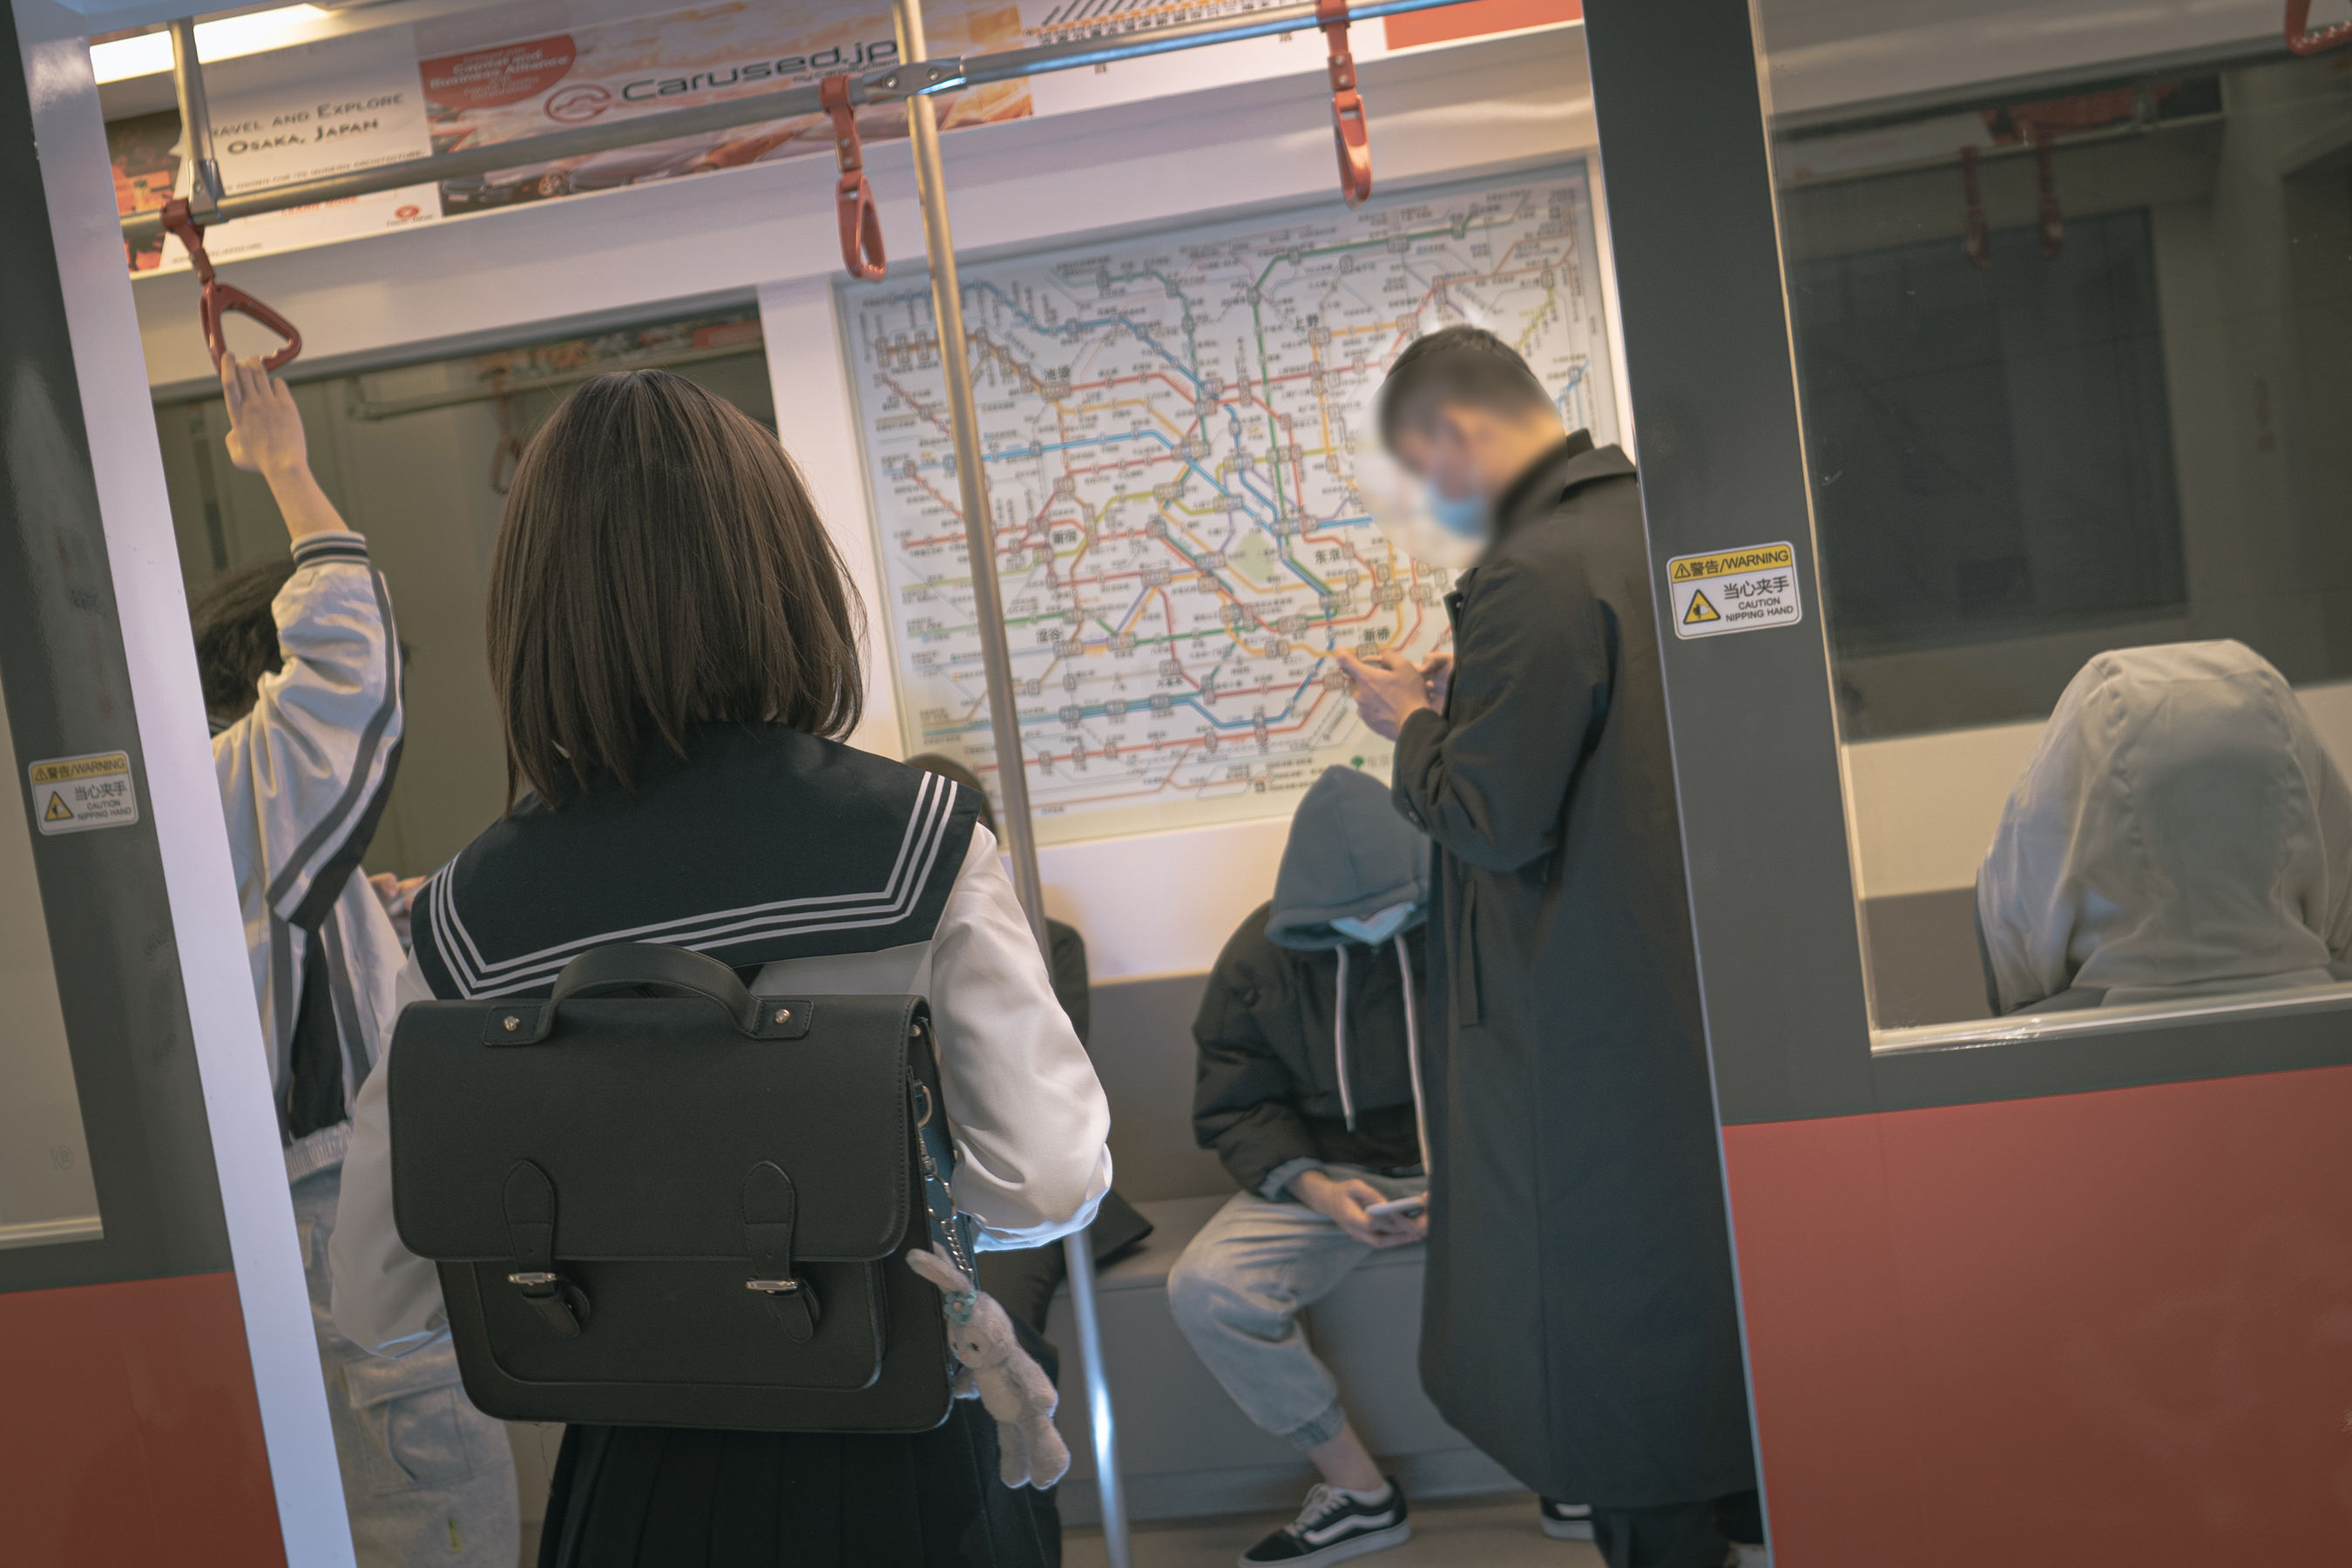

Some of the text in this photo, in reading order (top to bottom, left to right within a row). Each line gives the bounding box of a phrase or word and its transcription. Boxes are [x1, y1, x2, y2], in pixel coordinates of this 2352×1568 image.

[622, 39, 898, 101] Carused.jp
[211, 92, 403, 139] RAVEL AND EXPLORE
[227, 118, 378, 155] OSAKA, JAPAN
[1051, 530, 1077, 545] 新宿
[1314, 547, 1342, 564] 东京
[1723, 575, 1789, 600] 当心夹手
[1738, 597, 1781, 611] CAUTION
[1726, 605, 1794, 623] NIPPING HAND
[74, 780, 127, 801] 当心夹手
[78, 807, 132, 821] NIPPING HAND
[86, 800, 121, 810] CAUTION
